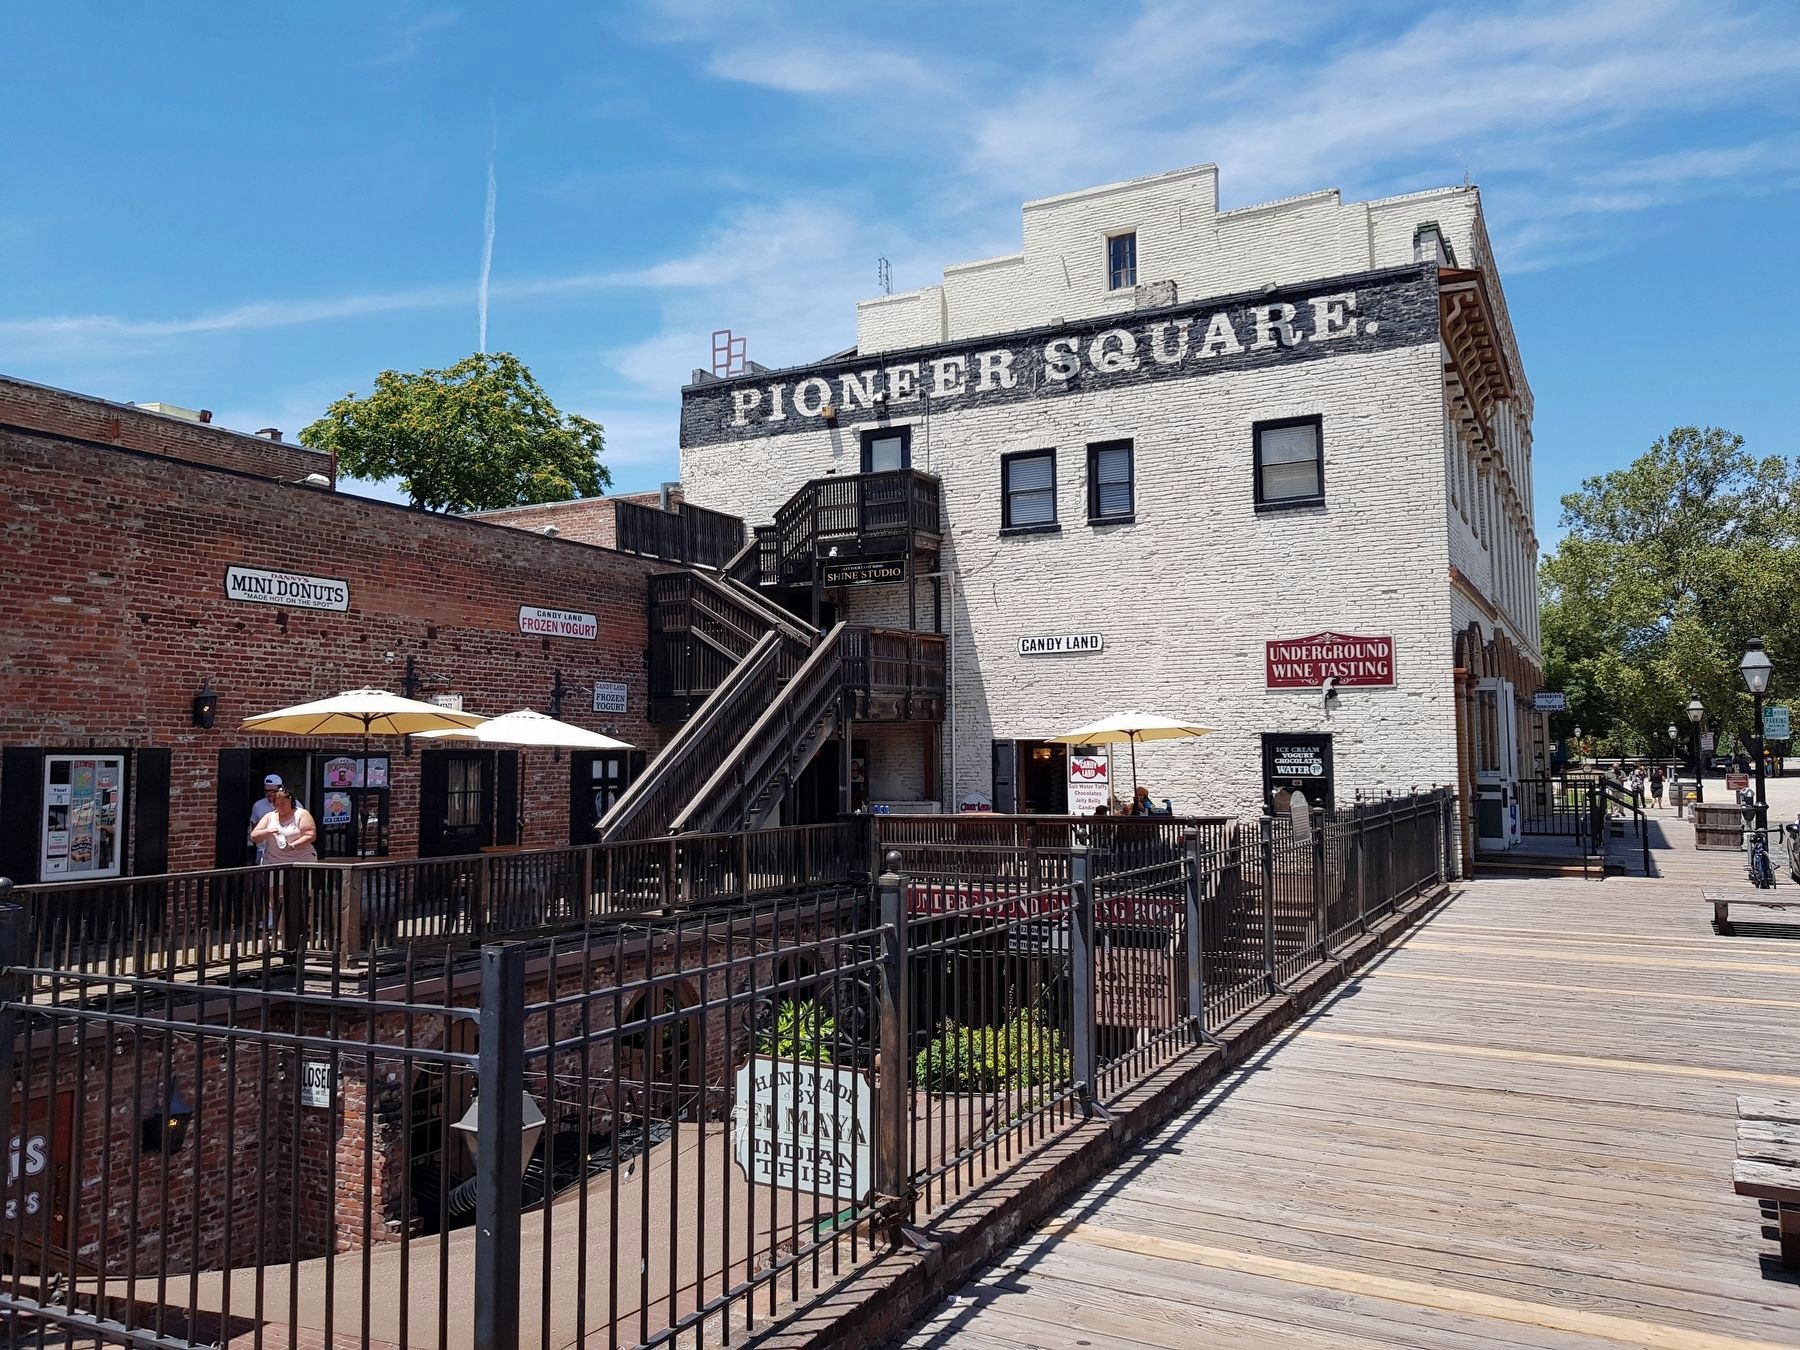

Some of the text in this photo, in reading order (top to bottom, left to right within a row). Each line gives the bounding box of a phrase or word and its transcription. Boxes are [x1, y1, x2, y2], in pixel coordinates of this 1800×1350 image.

[731, 291, 1380, 427] PIONEER SQUARE.
[271, 573, 310, 583] DANNY'S
[827, 571, 859, 582] SHINE
[861, 567, 901, 579] STUDIO
[231, 574, 344, 603] MINI DONUTS
[244, 592, 268, 601] "MADE
[537, 610, 583, 622] CANDY LAND
[522, 617, 596, 637] FROZEN YOGURT
[1021, 635, 1098, 652] CANDY LAND
[1269, 643, 1389, 661] UNDERGROUND
[1272, 661, 1388, 678] WINE TASTING
[596, 693, 625, 703] FROZEN
[596, 702, 625, 711] YOGURT
[1765, 708, 1771, 716] 2
[1276, 765, 1310, 775] WATER
[784, 1105, 867, 1144] MAYA
[754, 1138, 858, 1169] INDIAN
